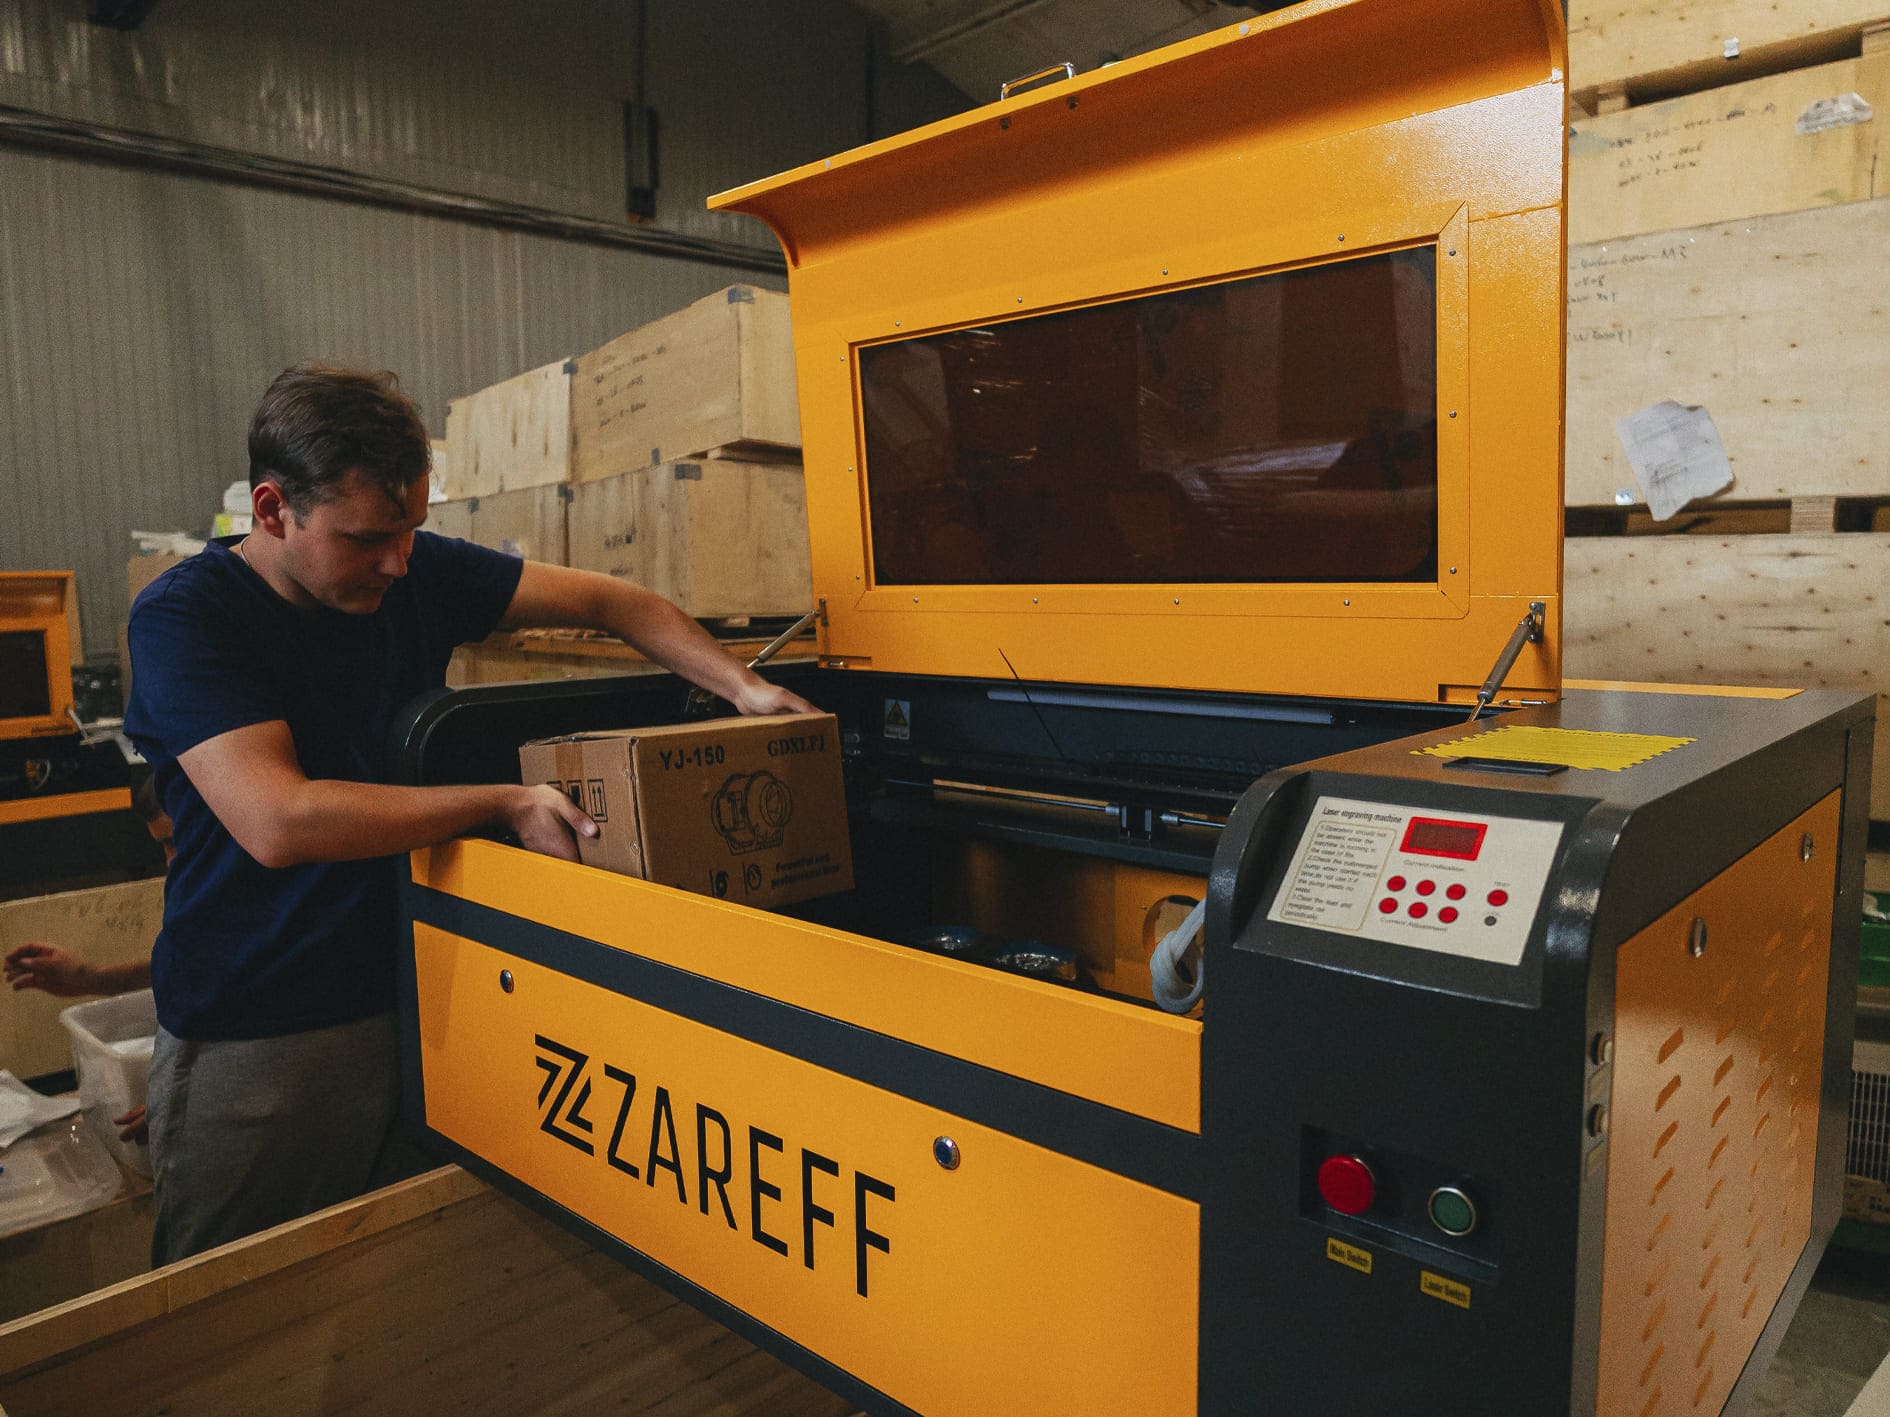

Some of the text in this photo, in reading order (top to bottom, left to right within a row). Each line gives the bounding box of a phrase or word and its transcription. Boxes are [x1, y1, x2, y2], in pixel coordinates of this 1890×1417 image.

[659, 745, 726, 771] YJ-150
[1323, 807, 1402, 823] Laser engraving machine
[604, 1063, 896, 1298] ZAREFF
[1347, 1249, 1370, 1268] Switch
[1444, 1285, 1467, 1303] Switch
